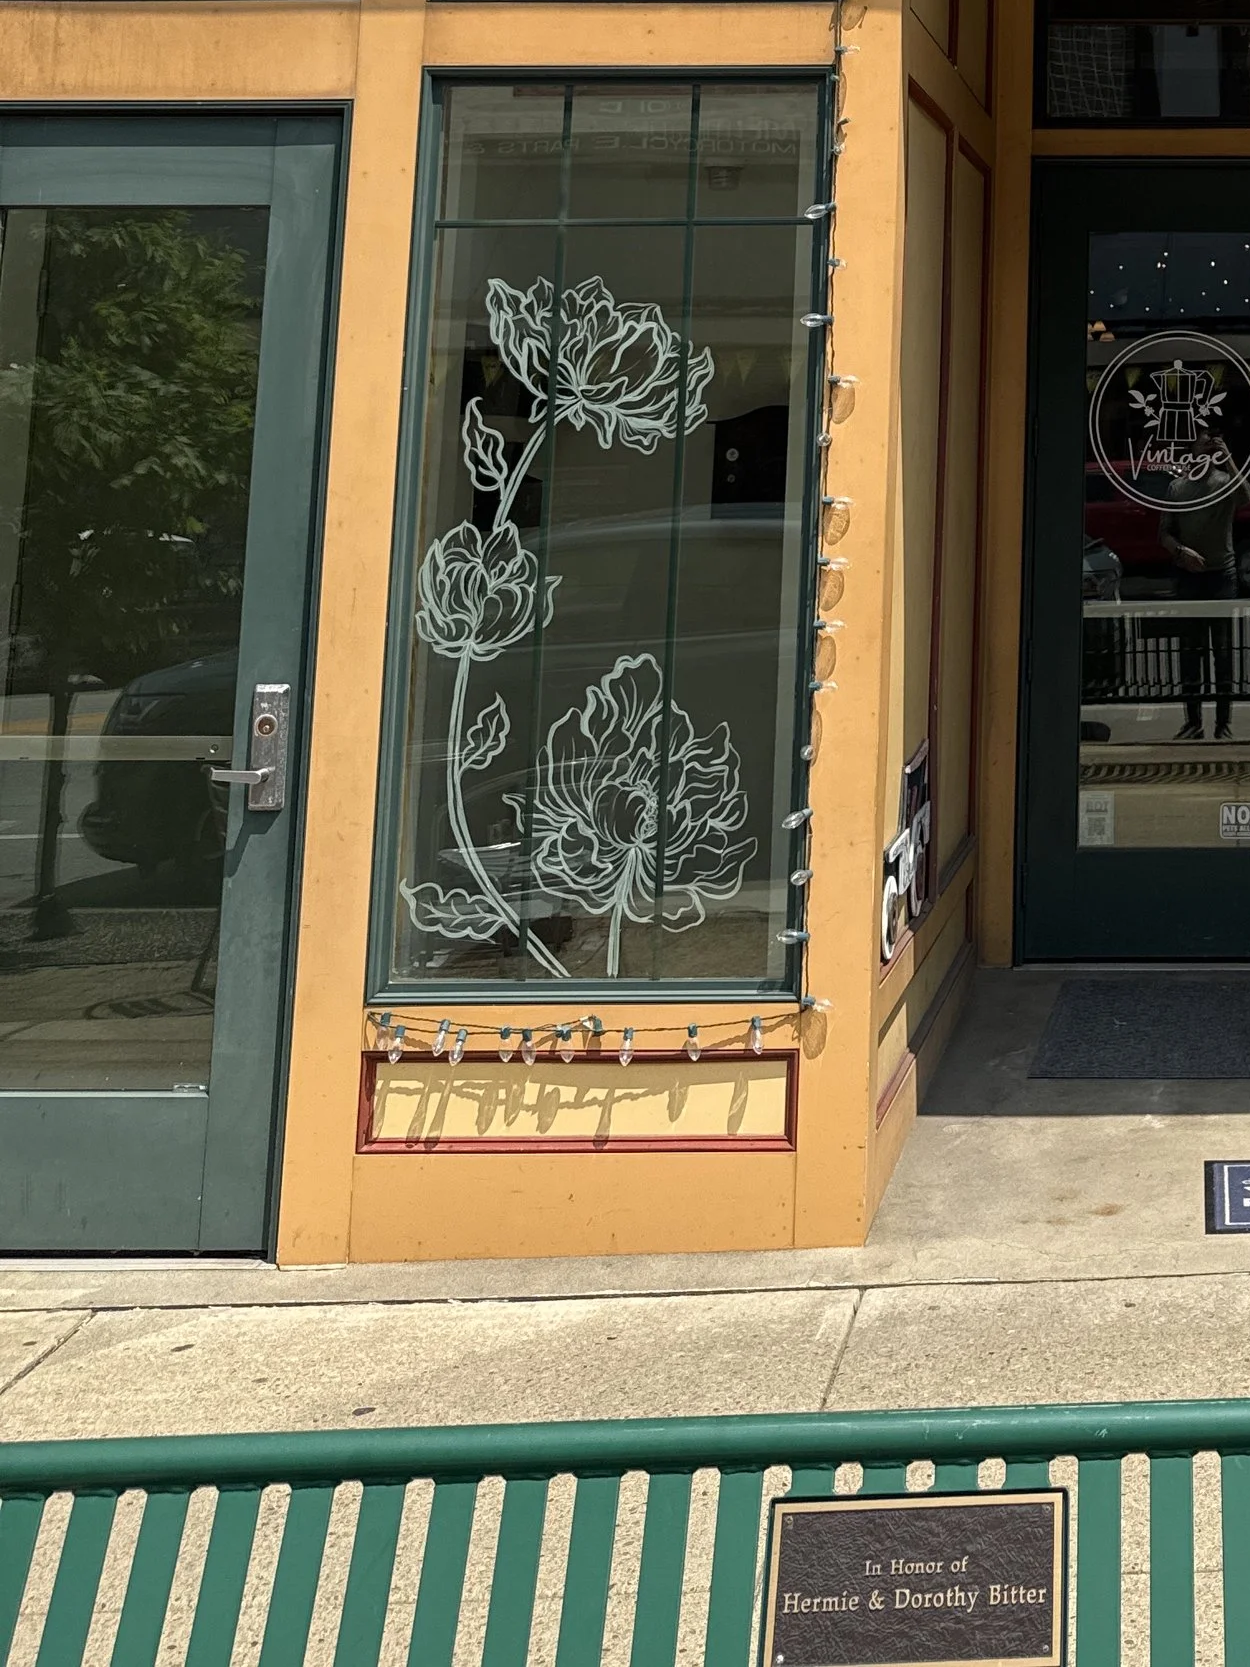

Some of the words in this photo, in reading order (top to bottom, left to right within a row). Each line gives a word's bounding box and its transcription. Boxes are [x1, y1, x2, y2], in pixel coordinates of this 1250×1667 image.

[1128, 434, 1232, 480] Vintage
[1222, 805, 1250, 824] NO
[864, 1559, 881, 1577] In
[890, 1559, 943, 1576] Honor
[951, 1556, 970, 1573] of
[781, 1591, 859, 1616] Hermie
[868, 1589, 885, 1610] &
[894, 1586, 980, 1613] Dorothy
[989, 1584, 1047, 1606] Bitter
